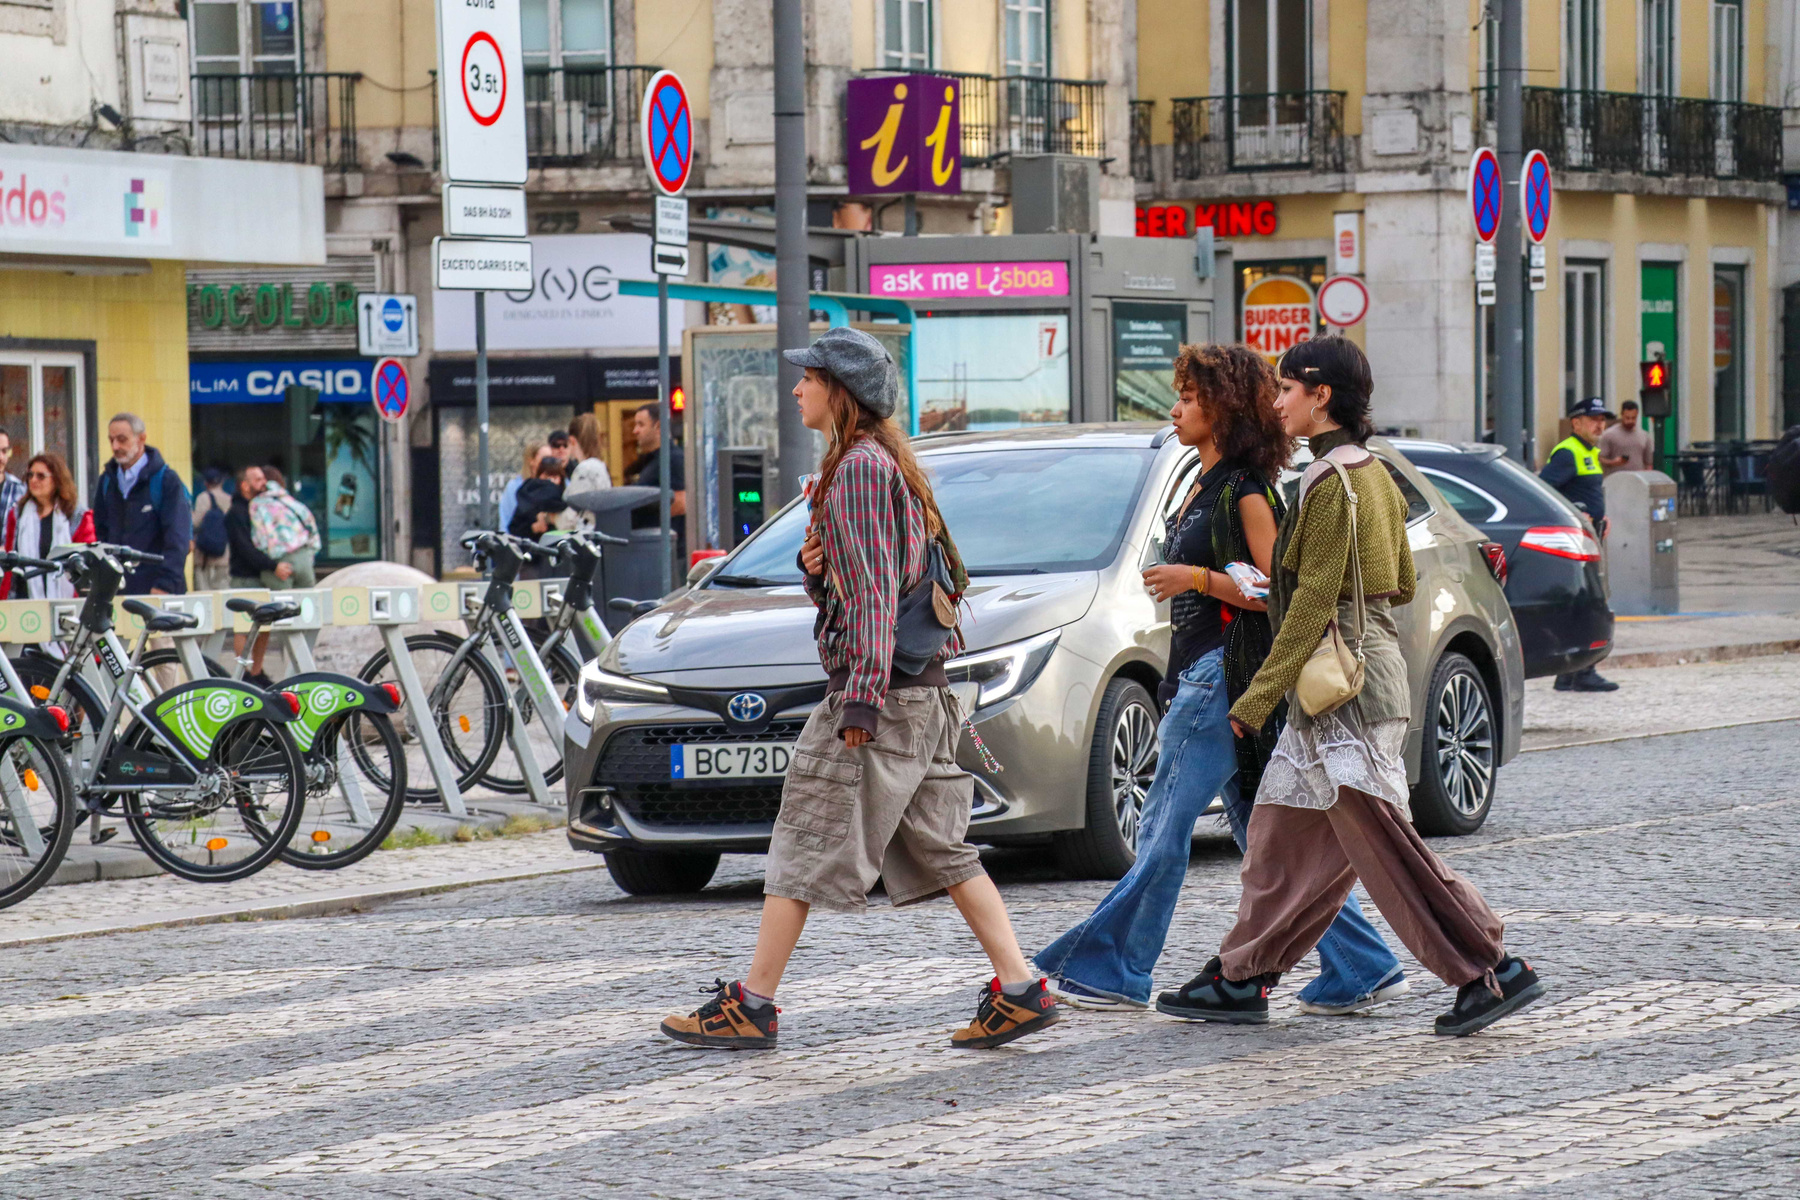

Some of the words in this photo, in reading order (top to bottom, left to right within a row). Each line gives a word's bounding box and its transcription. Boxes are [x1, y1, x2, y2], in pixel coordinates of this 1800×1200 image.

[463, 206, 477, 217] DAS
[1195, 201, 1277, 237] KING
[442, 258, 476, 270] EXCETO
[477, 259, 507, 271] CARRIS
[508, 260, 513, 271] E
[882, 268, 924, 292] ask
[932, 271, 969, 291] me
[187, 282, 356, 327] OCOLOR
[1245, 308, 1310, 325] BURGER
[1246, 327, 1309, 351] KING
[247, 369, 362, 396] CASIO
[674, 765, 681, 773] P
